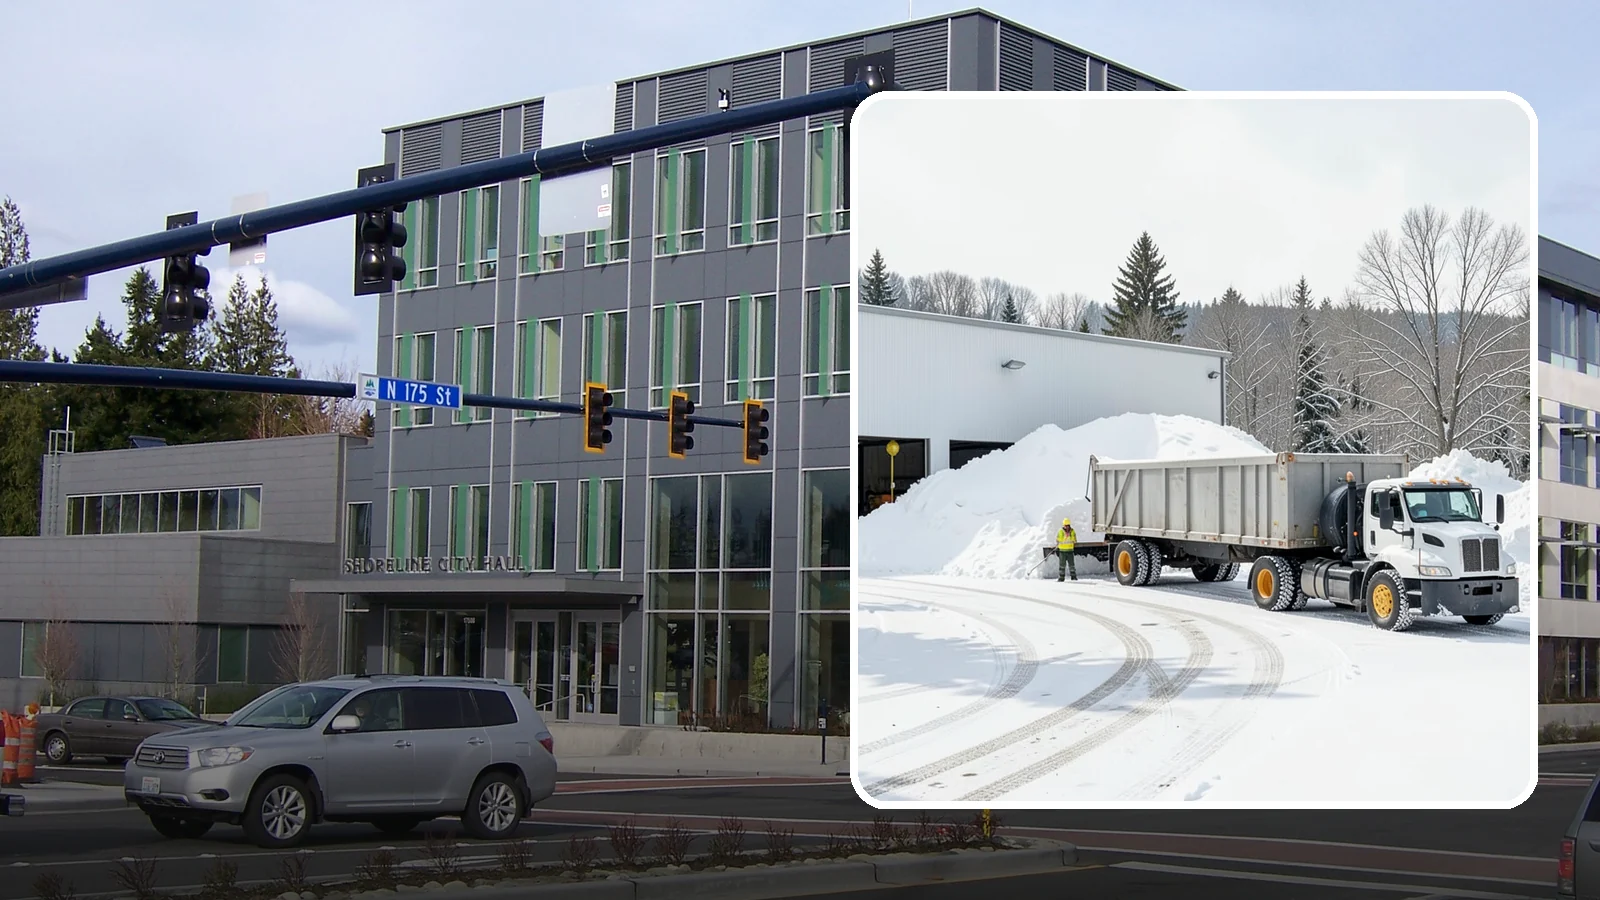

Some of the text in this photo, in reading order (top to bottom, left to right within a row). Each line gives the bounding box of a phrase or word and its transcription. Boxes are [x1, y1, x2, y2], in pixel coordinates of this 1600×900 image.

[387, 380, 451, 406] N 175 St
[344, 555, 526, 574] SHORELINE CITY HALL
